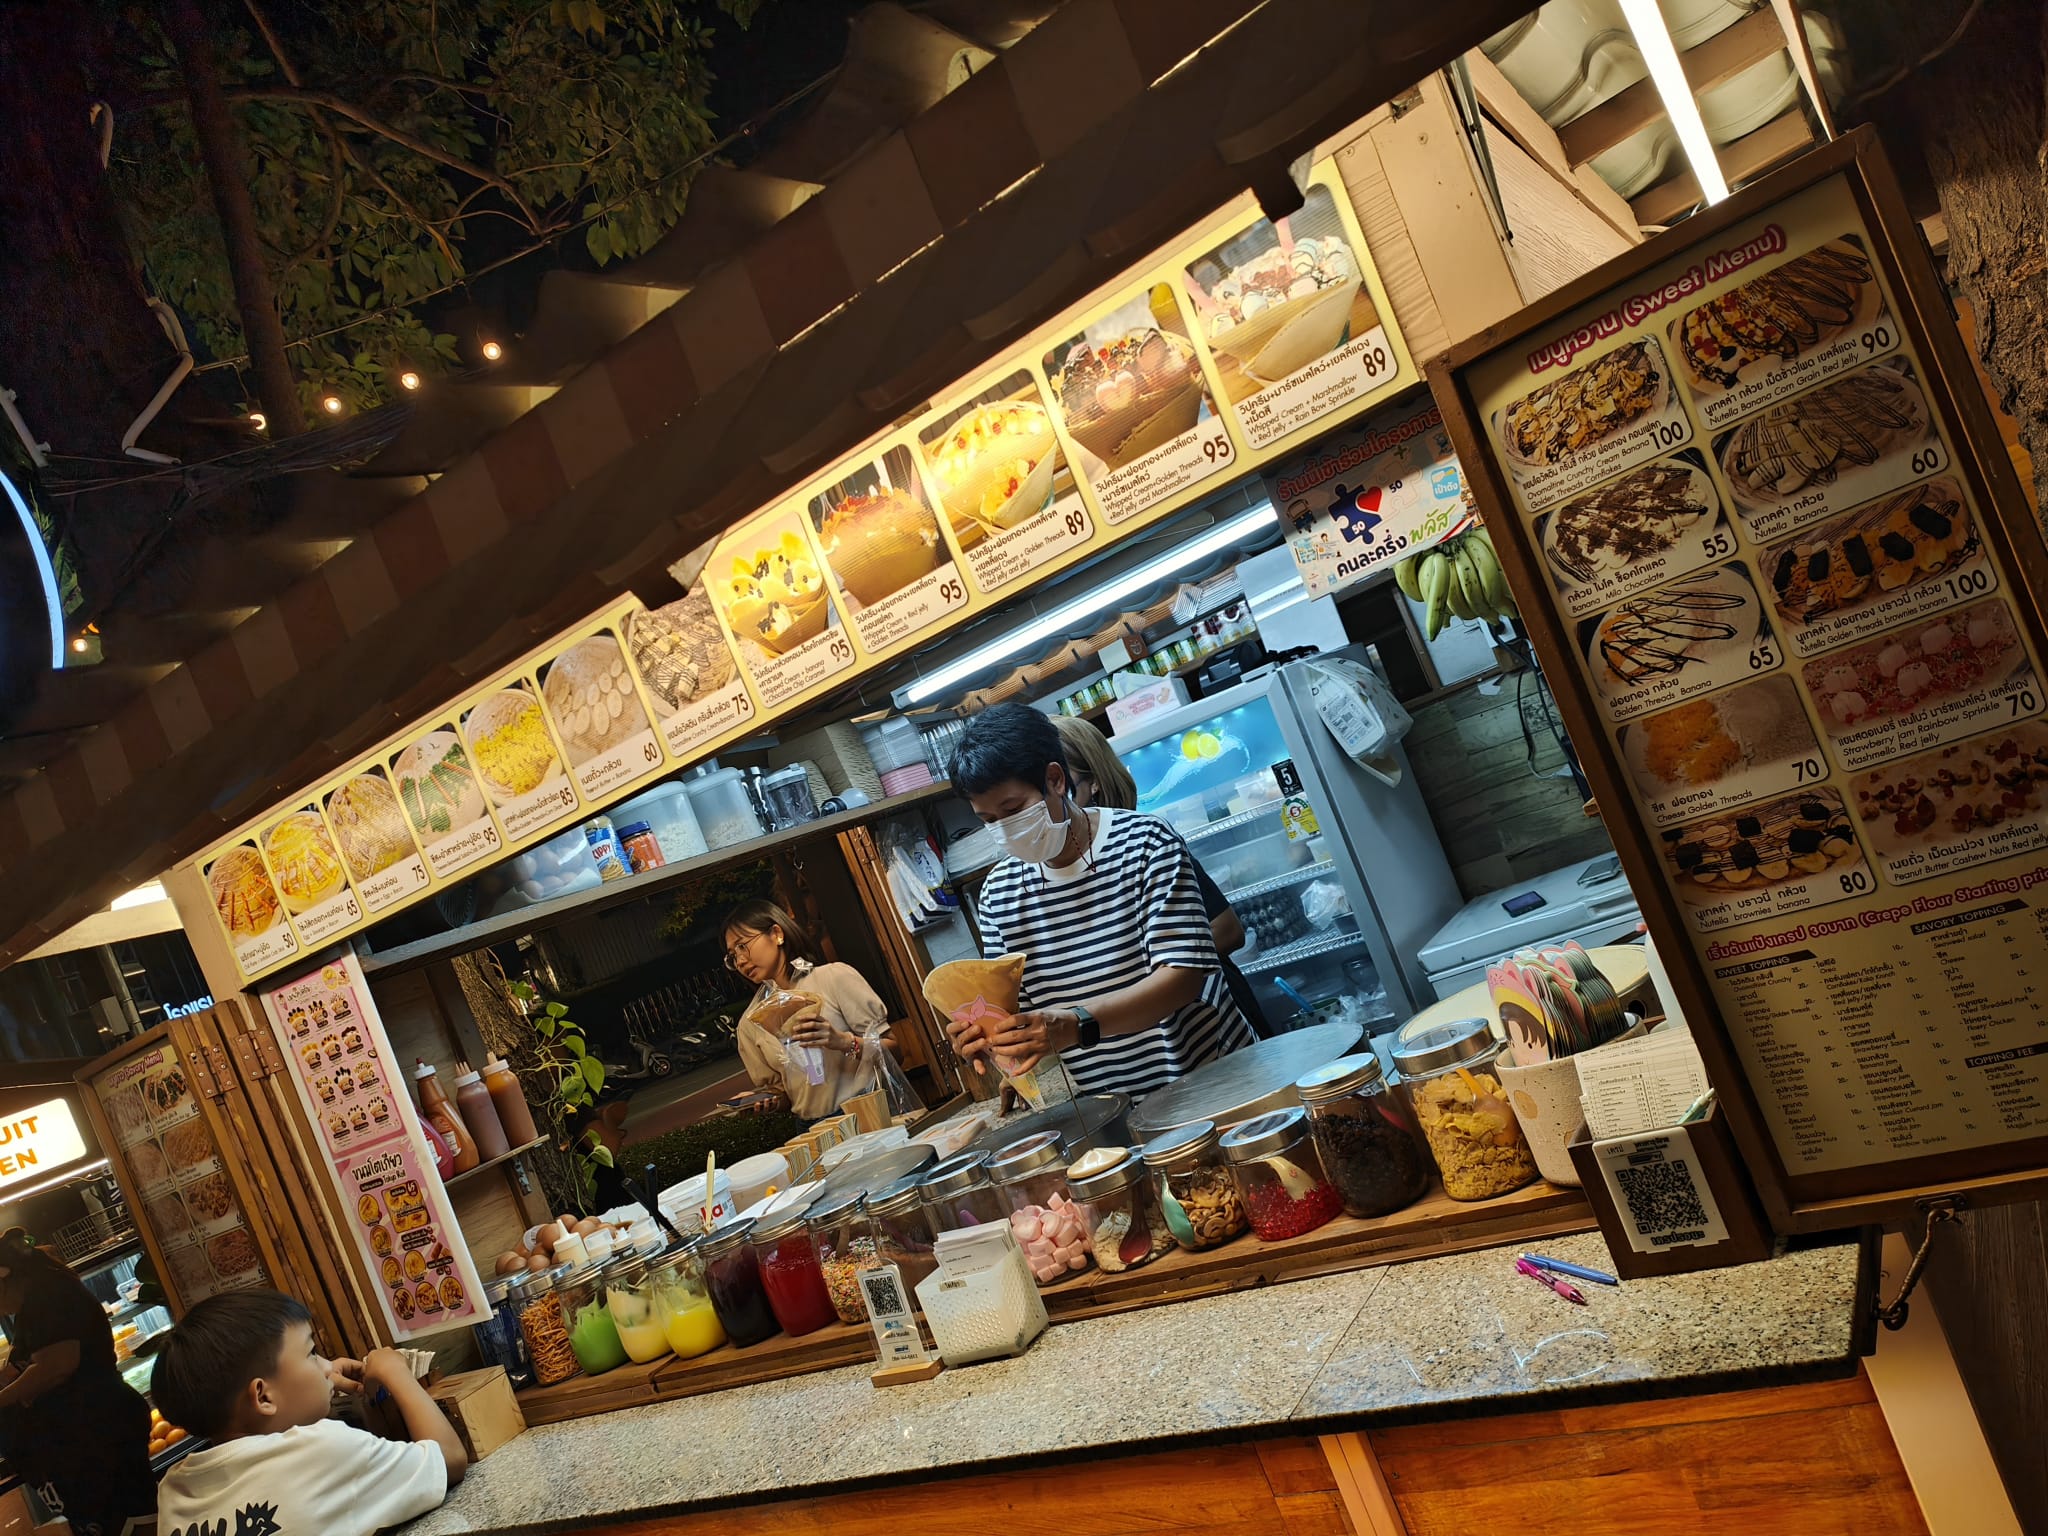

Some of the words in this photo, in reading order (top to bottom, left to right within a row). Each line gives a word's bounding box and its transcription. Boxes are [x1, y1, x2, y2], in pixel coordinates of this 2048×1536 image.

[1526, 312, 1623, 377] เมนูหวาน
[1618, 266, 1706, 326] (Sweet
[1701, 224, 1786, 283] Menu)
[1860, 326, 1890, 354] 90
[1362, 346, 1386, 377] 89
[1708, 406, 1739, 426] Nutella
[1739, 392, 1772, 411] Banana
[1773, 382, 1795, 396] Corn
[1795, 370, 1821, 386] Grain
[1821, 360, 1839, 374] Red
[1737, 380, 1763, 399] กล้วย
[1247, 413, 1281, 436] Whipped
[1280, 402, 1304, 419] Cream
[1311, 373, 1357, 403] Marshmallow
[1257, 429, 1272, 441] Red
[1271, 422, 1286, 436] jelly
[1294, 410, 1310, 422] Rain
[1310, 401, 1326, 414] Bow
[1327, 385, 1355, 406] Sprinkle
[1202, 433, 1229, 463] 95
[1648, 420, 1683, 450] 100
[1565, 465, 1594, 482] Crunchy
[1595, 452, 1620, 468] Cream
[1620, 438, 1650, 456] Banana
[1911, 447, 1938, 474] 60
[1104, 491, 1133, 514] Whipped
[1178, 454, 1203, 473] Threads
[1389, 479, 1404, 494] 50
[1529, 493, 1556, 509] Golden
[1555, 479, 1584, 497] Threads
[1584, 462, 1622, 484] Cornflakes
[1137, 493, 1151, 505] and
[1792, 491, 1824, 511] กล้วย
[1064, 509, 1084, 535] 89
[1351, 520, 1366, 535] 50
[1754, 521, 1787, 540] Nutella
[1792, 505, 1829, 524] Banana
[1336, 528, 1408, 578] คนละครึ่ง
[1701, 532, 1728, 558] 55
[939, 578, 962, 604] 95
[1566, 587, 1592, 603] กล้วย
[1592, 577, 1614, 592] ไมโล
[1571, 597, 1601, 613] Banana
[1604, 588, 1622, 600] Milo
[1623, 571, 1664, 592] Chocolate
[1944, 568, 1987, 599] 100
[1833, 603, 1875, 629] ฝอยทอง
[1912, 583, 1942, 600] กล้วย
[1799, 638, 1826, 653] Nutella
[1826, 629, 1854, 644] Golden
[1853, 617, 1884, 634] Threads
[1883, 606, 1918, 624] brownies
[1917, 596, 1948, 611] banana
[829, 638, 850, 662] 95
[1748, 645, 1774, 670] 65
[730, 692, 749, 715] 75
[1609, 687, 1650, 708] ฝอยทอง
[1651, 677, 1679, 693] กล้วย
[1613, 703, 1643, 718] Golden
[1643, 690, 1675, 707] Threads
[1679, 679, 1712, 695] Banana
[2004, 689, 2035, 717] 70
[1842, 734, 1895, 756] Strawberry
[1896, 728, 1915, 741] jam
[1916, 714, 1959, 733] Rainbow
[1961, 700, 2000, 720] Sprinkle
[642, 741, 658, 762] 60
[1846, 743, 1896, 767] Mashmello
[1898, 737, 1918, 751] Red
[1919, 731, 1940, 747] jelly
[1791, 758, 1819, 782] 70
[558, 786, 574, 806] 85
[1655, 809, 1686, 823] Cheese
[1686, 800, 1718, 814] Golden
[1719, 788, 1753, 805] Threads
[1670, 788, 1713, 807] ฝอยทอง
[482, 826, 497, 845] 95
[592, 843, 612, 860] KIPPY
[1893, 866, 1922, 881] Peanut
[1924, 861, 1949, 873] Butter
[1951, 850, 1987, 866] Cashew
[1988, 844, 2010, 856] Nuts
[2011, 837, 2029, 850] Red
[411, 863, 425, 882] 75
[1839, 870, 1866, 893] 80
[1776, 884, 1807, 898] กล้วย
[1857, 900, 1913, 931] (Crepe
[1912, 889, 1954, 914] Flour
[1953, 873, 2021, 907] Starting
[345, 898, 358, 916] 65
[1699, 915, 1729, 929] Nutella
[1733, 906, 1772, 921] brownies
[1776, 897, 1810, 911] banana
[1914, 916, 1956, 933] SAVORY
[1958, 904, 2007, 922] TOPPING
[281, 931, 294, 948] 50
[1717, 964, 1747, 977] SWEET
[1748, 954, 1791, 971] TOPPING
[1967, 1049, 2015, 1067] TOPPING
